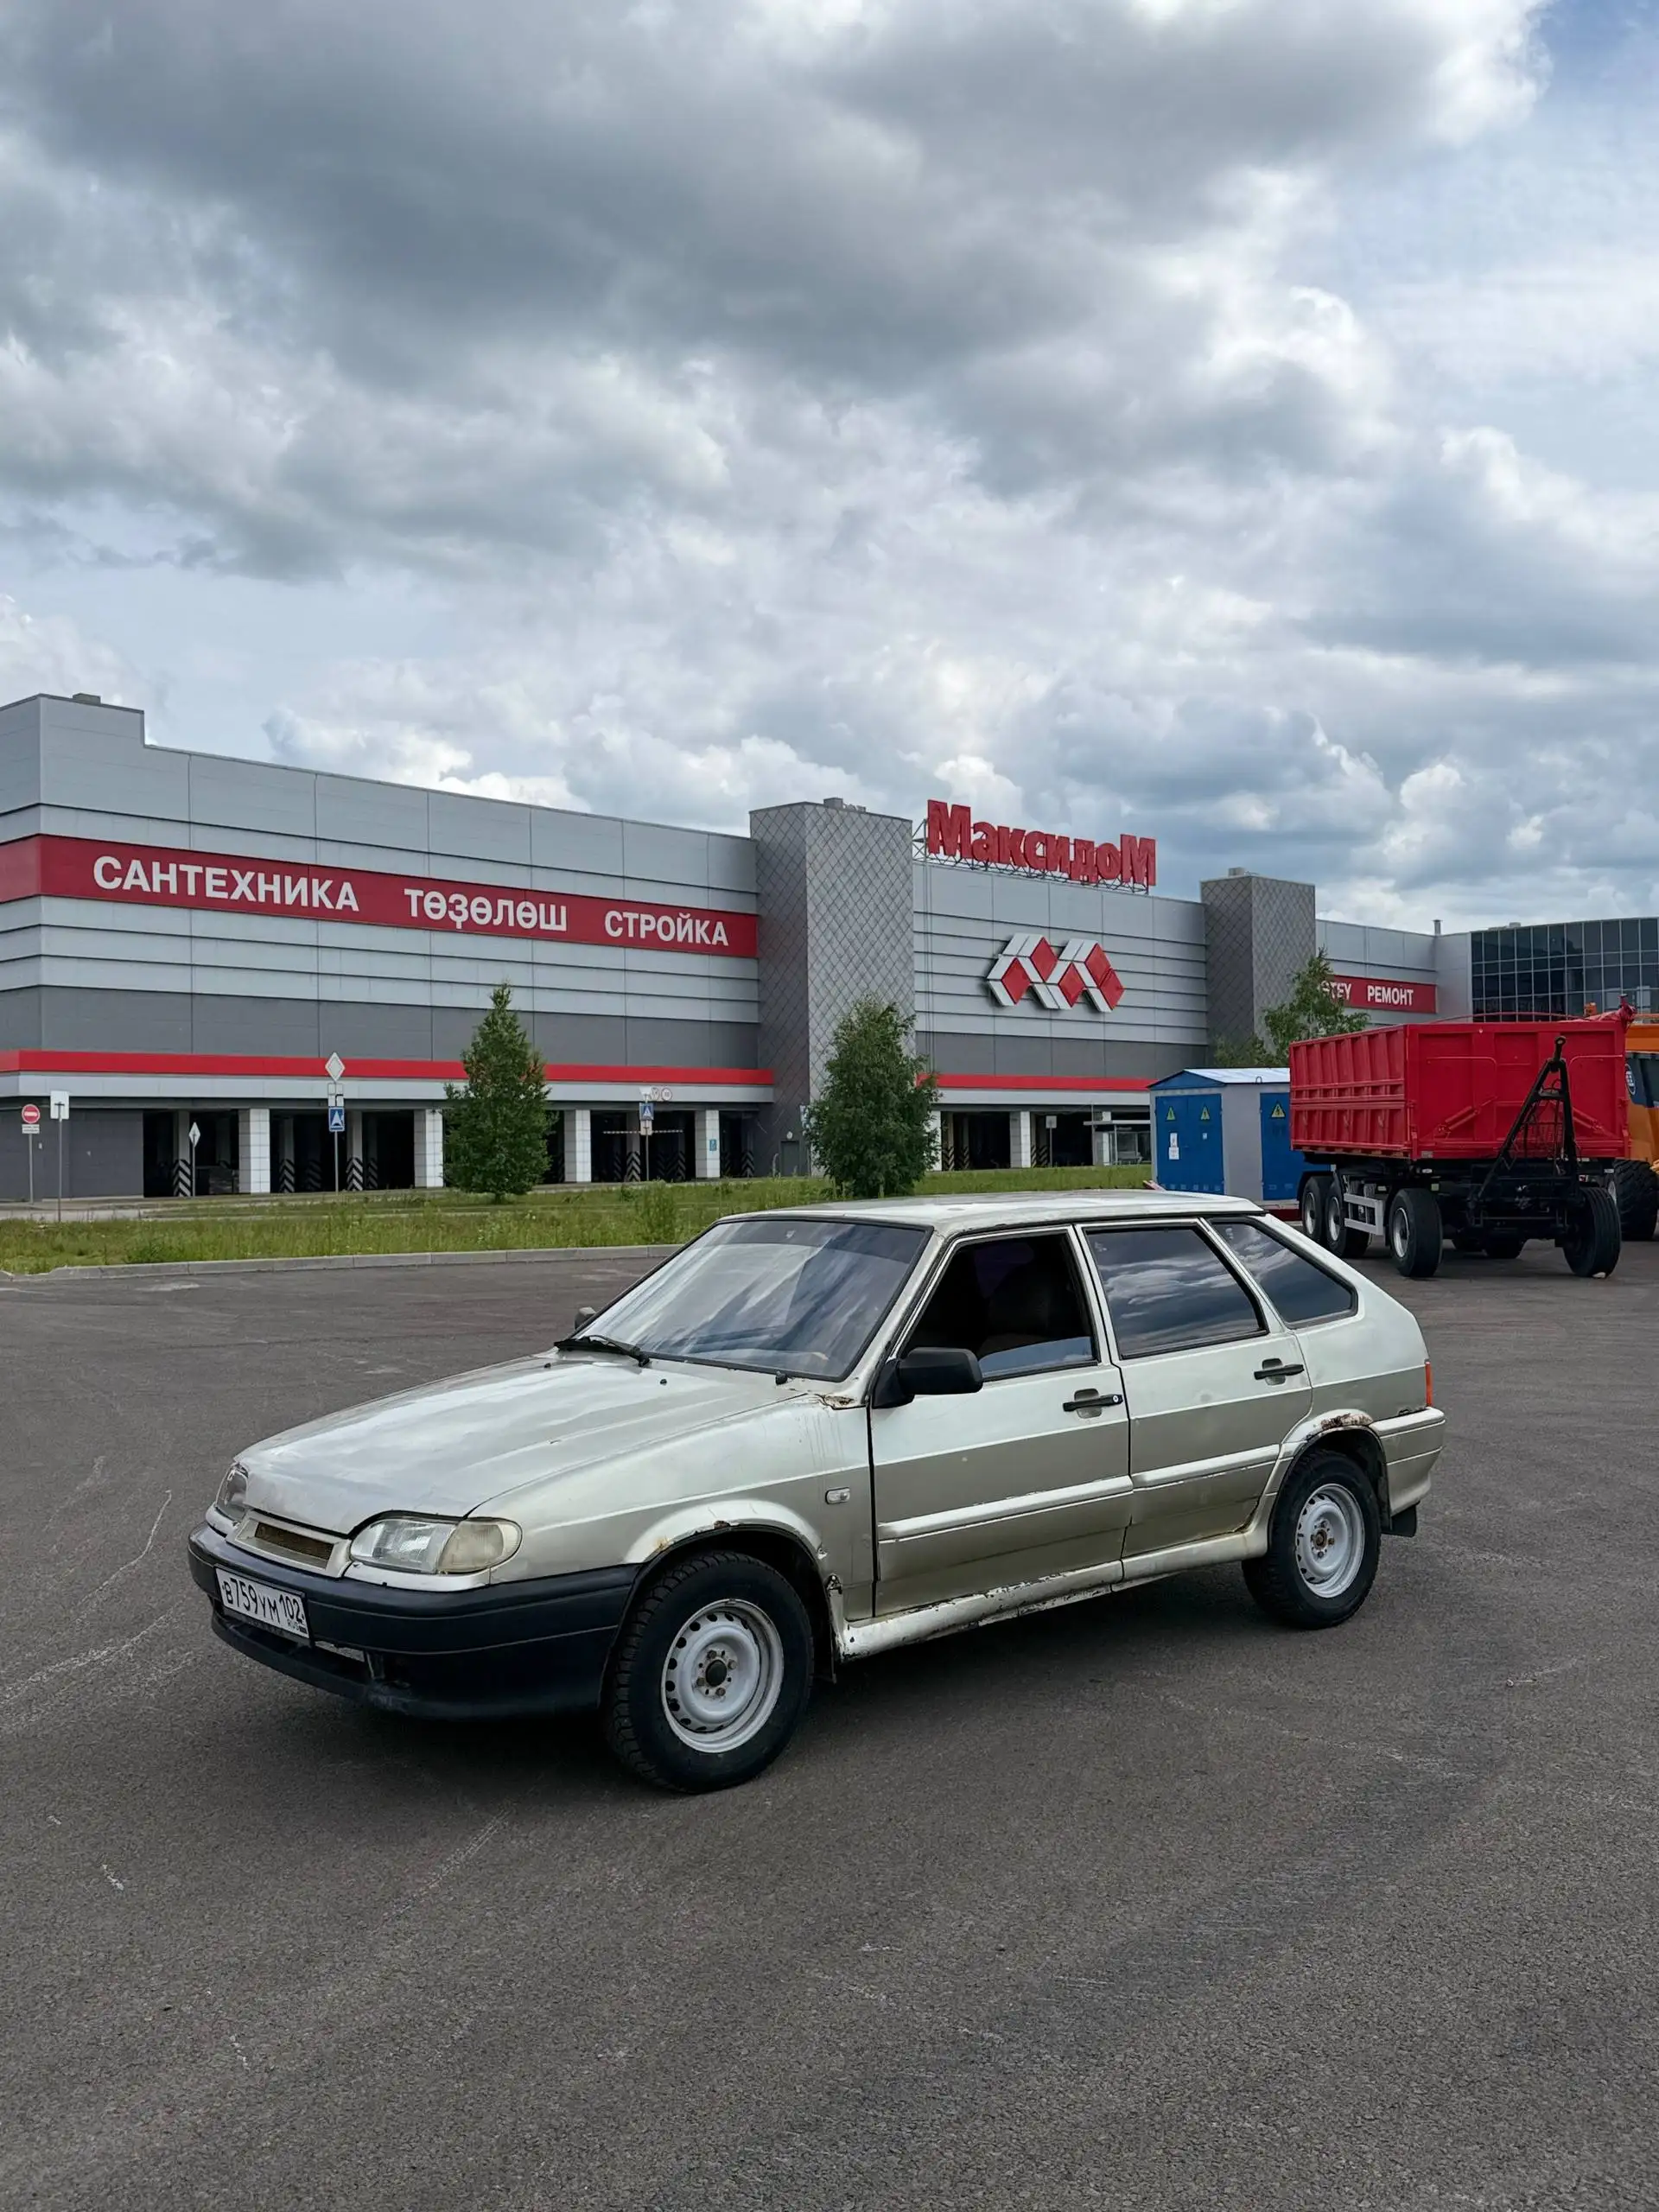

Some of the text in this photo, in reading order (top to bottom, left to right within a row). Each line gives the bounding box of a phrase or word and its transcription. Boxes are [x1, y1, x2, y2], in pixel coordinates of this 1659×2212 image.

[92, 855, 360, 912] САНТЕХНИКА
[604, 912, 729, 946] СТРОЙКА
[1367, 985, 1414, 1006] РЕМОНТ
